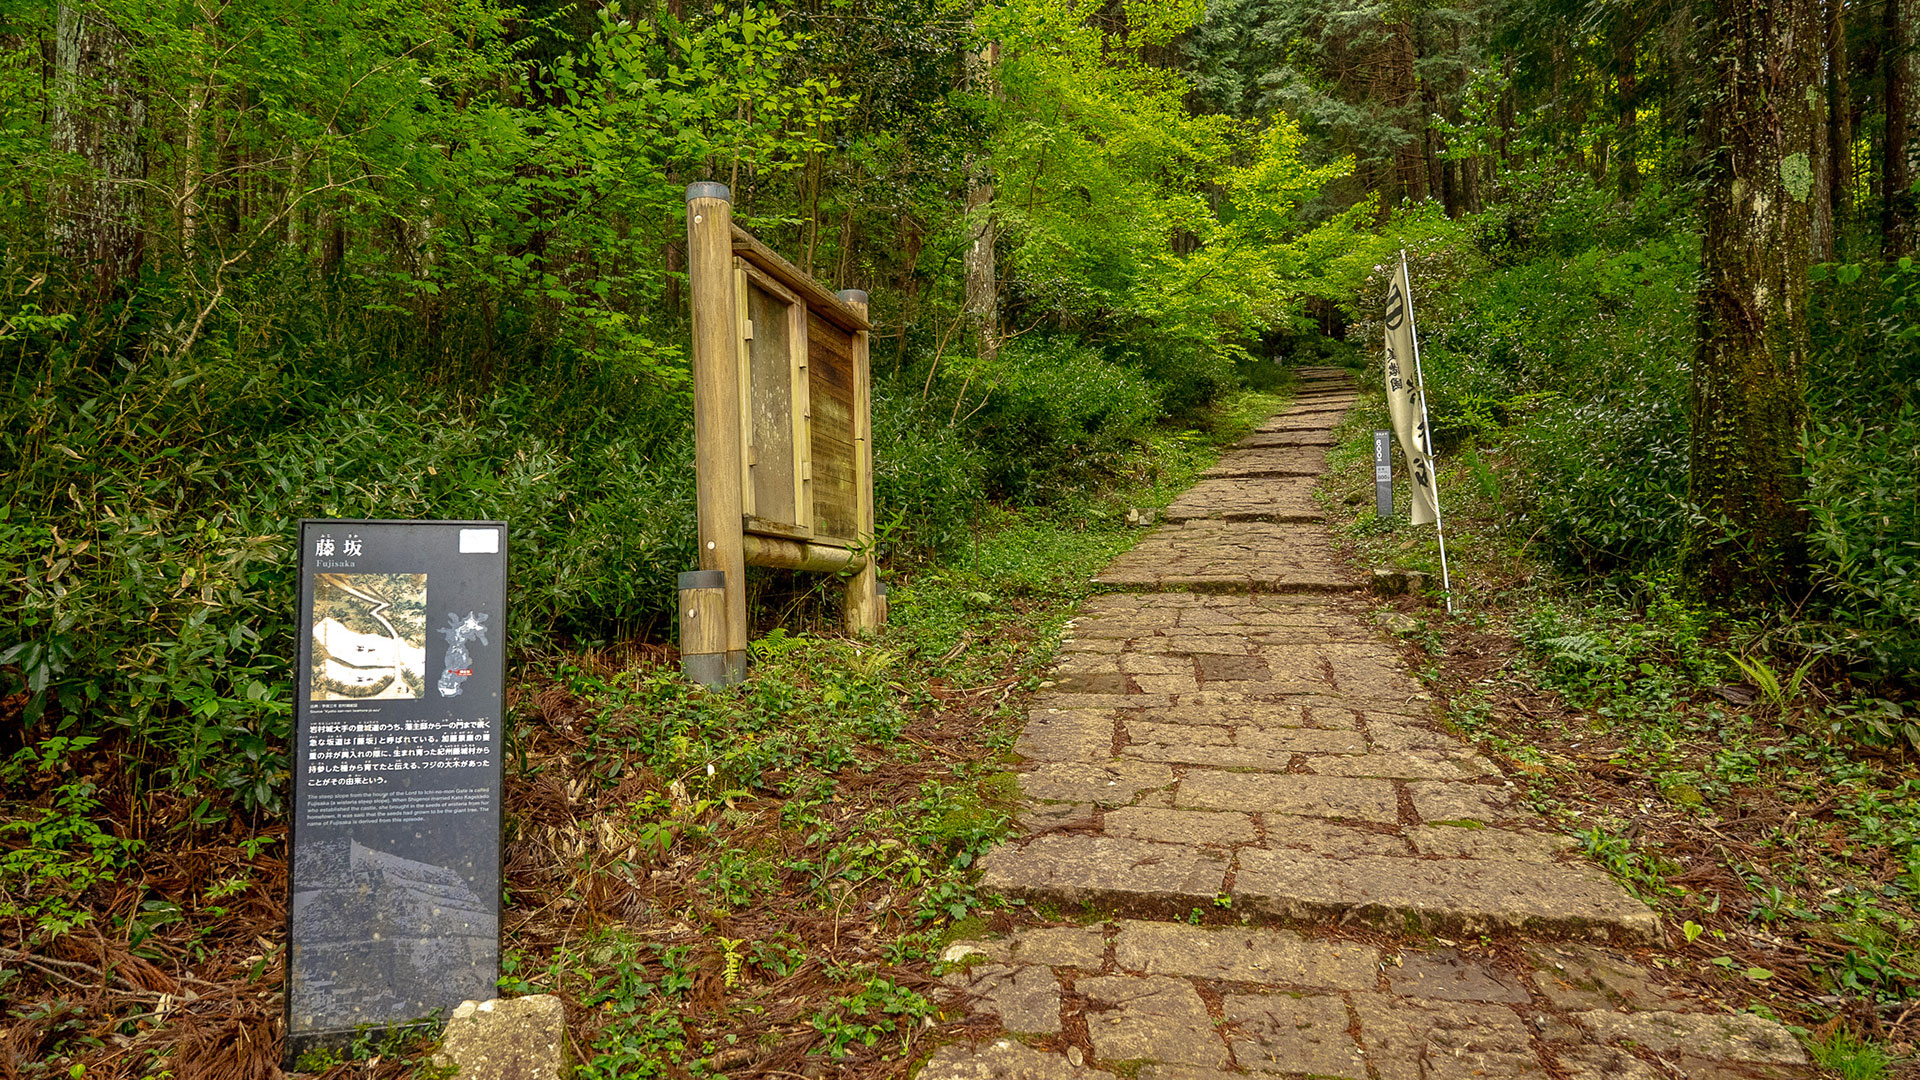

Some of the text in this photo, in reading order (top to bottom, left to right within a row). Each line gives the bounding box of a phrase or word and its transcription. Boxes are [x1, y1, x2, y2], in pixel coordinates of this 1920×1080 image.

[315, 538, 363, 557] 藤坂
[316, 559, 355, 568] Fujisaka
[308, 776, 388, 786] ことがその由来という。
